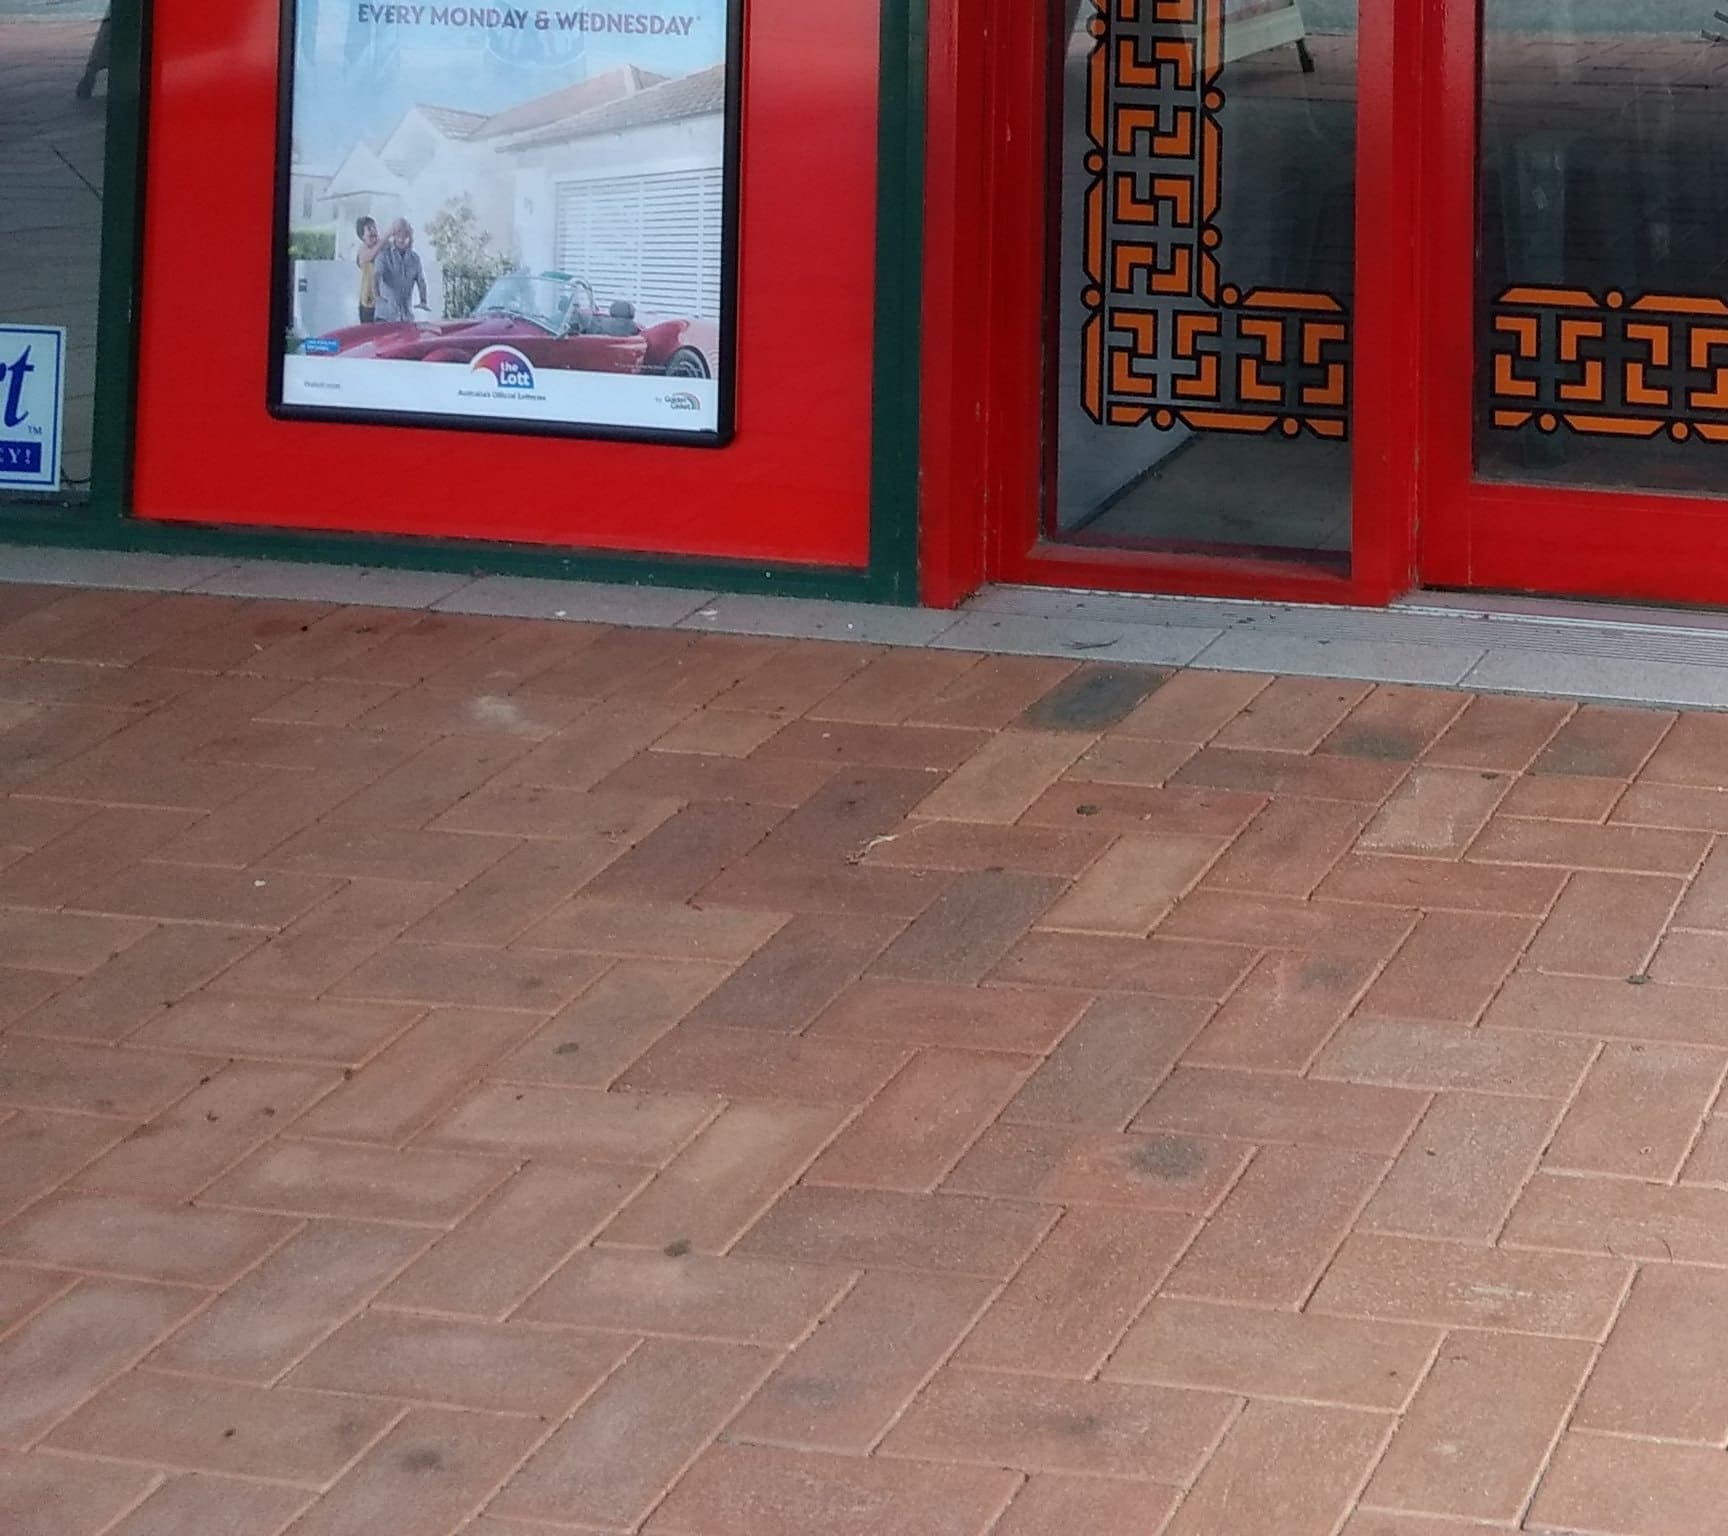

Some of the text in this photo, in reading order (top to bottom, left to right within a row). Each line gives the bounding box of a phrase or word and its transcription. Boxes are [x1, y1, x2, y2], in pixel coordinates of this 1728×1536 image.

[358, 4, 694, 36] EVERY MONDAY & WEDNESDAY
[500, 361, 519, 372] the
